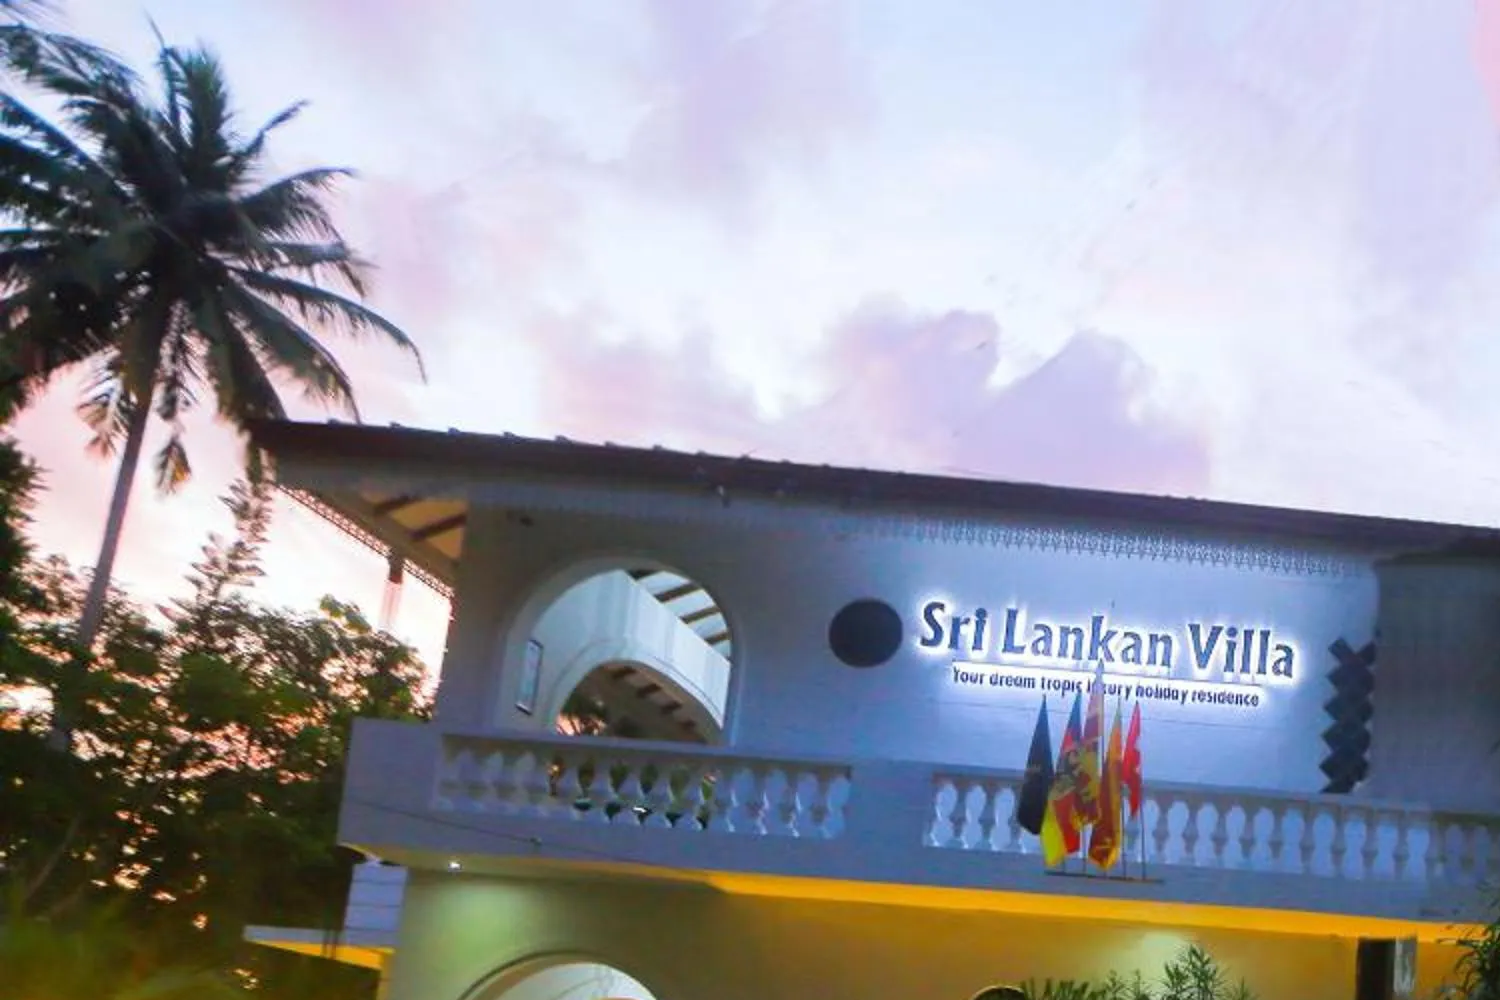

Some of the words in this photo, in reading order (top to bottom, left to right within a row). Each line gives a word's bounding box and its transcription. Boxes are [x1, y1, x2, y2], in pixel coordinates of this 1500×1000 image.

[920, 602, 988, 651] Sri
[1001, 608, 1172, 668] Lankan
[1188, 623, 1295, 678] Villa
[953, 666, 985, 685] Your
[989, 673, 1036, 689] dream
[1136, 682, 1188, 705] holiday
